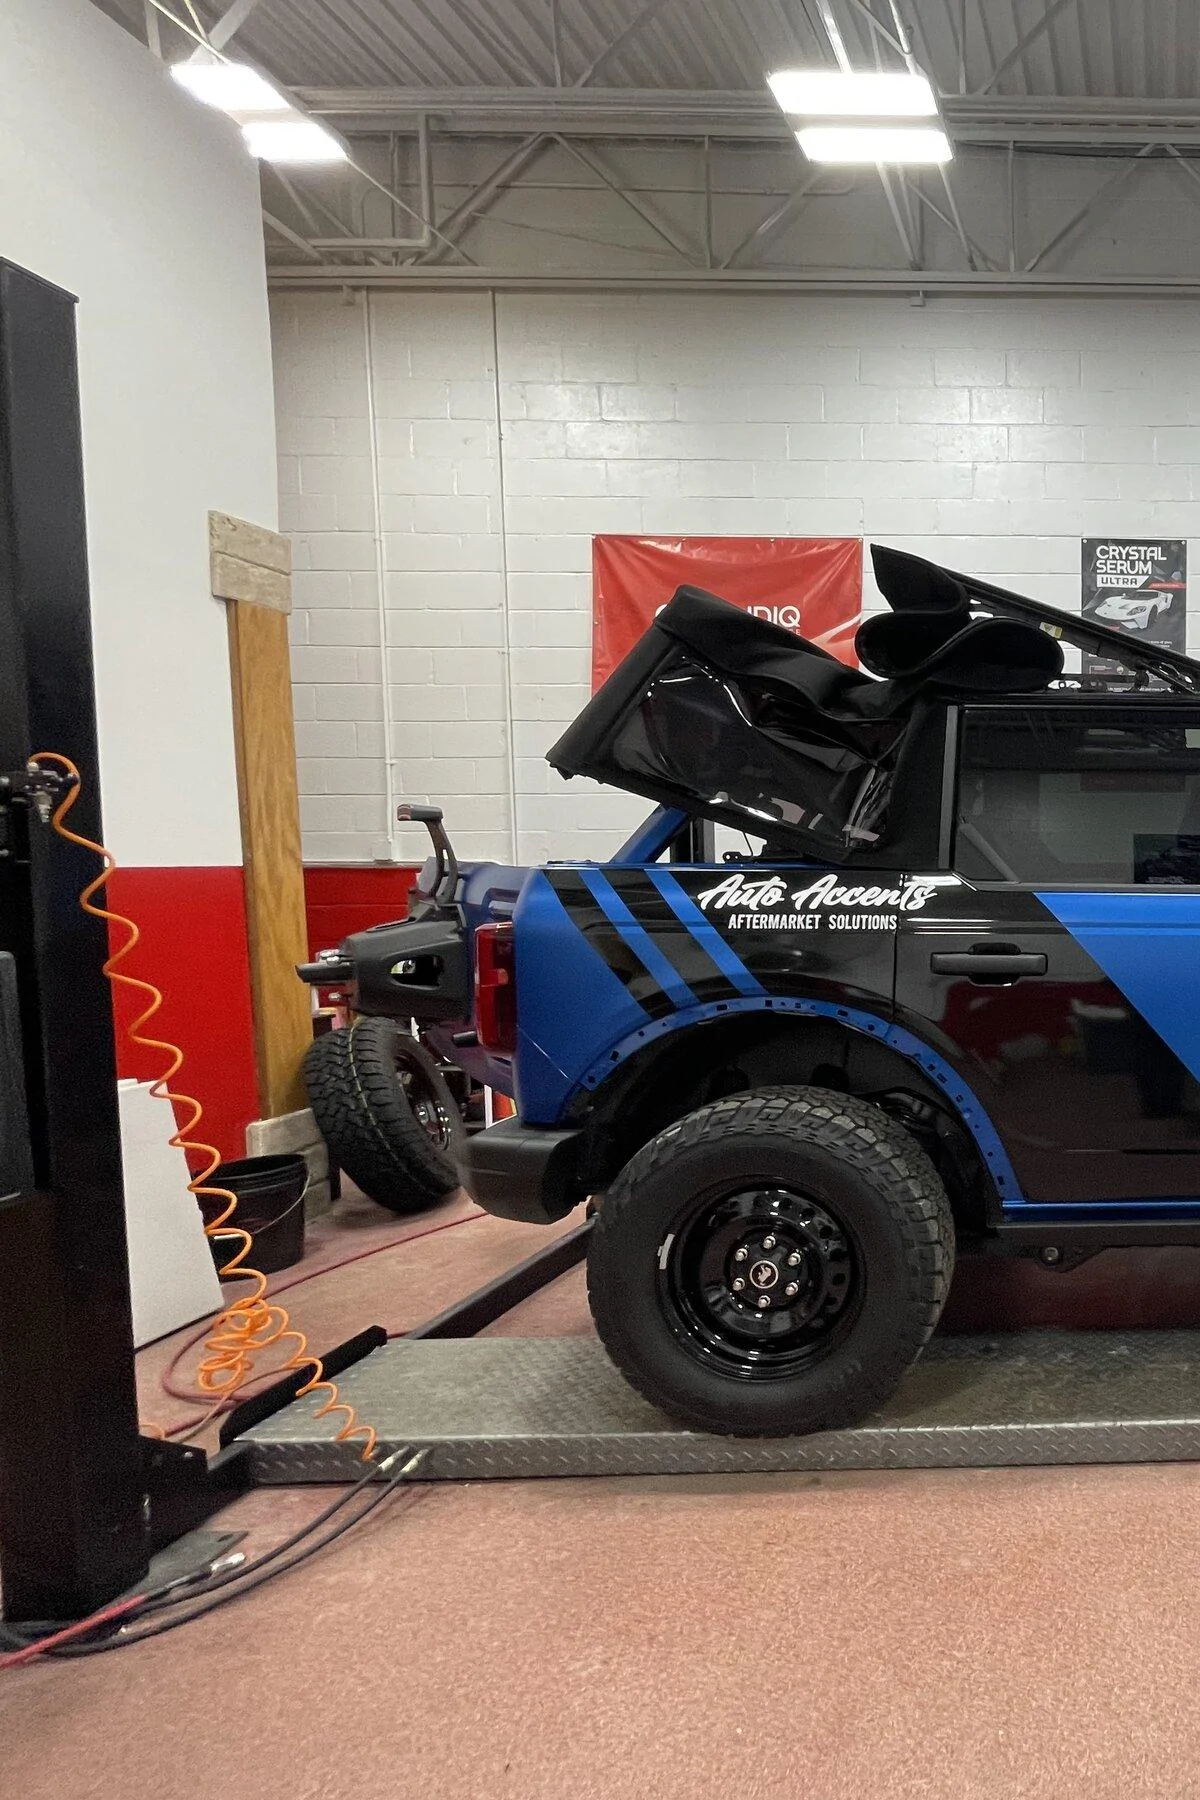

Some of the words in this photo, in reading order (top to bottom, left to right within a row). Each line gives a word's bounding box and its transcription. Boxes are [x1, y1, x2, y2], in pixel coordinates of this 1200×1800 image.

[1096, 545, 1167, 560] CRYSTAL
[1096, 560, 1152, 575] SERUM
[1101, 577, 1138, 586] ULTRA
[698, 873, 788, 911] Auto
[791, 873, 938, 911] Accents
[728, 913, 821, 930] AFTERMARKET
[829, 913, 898, 930] SOLUTIONS
